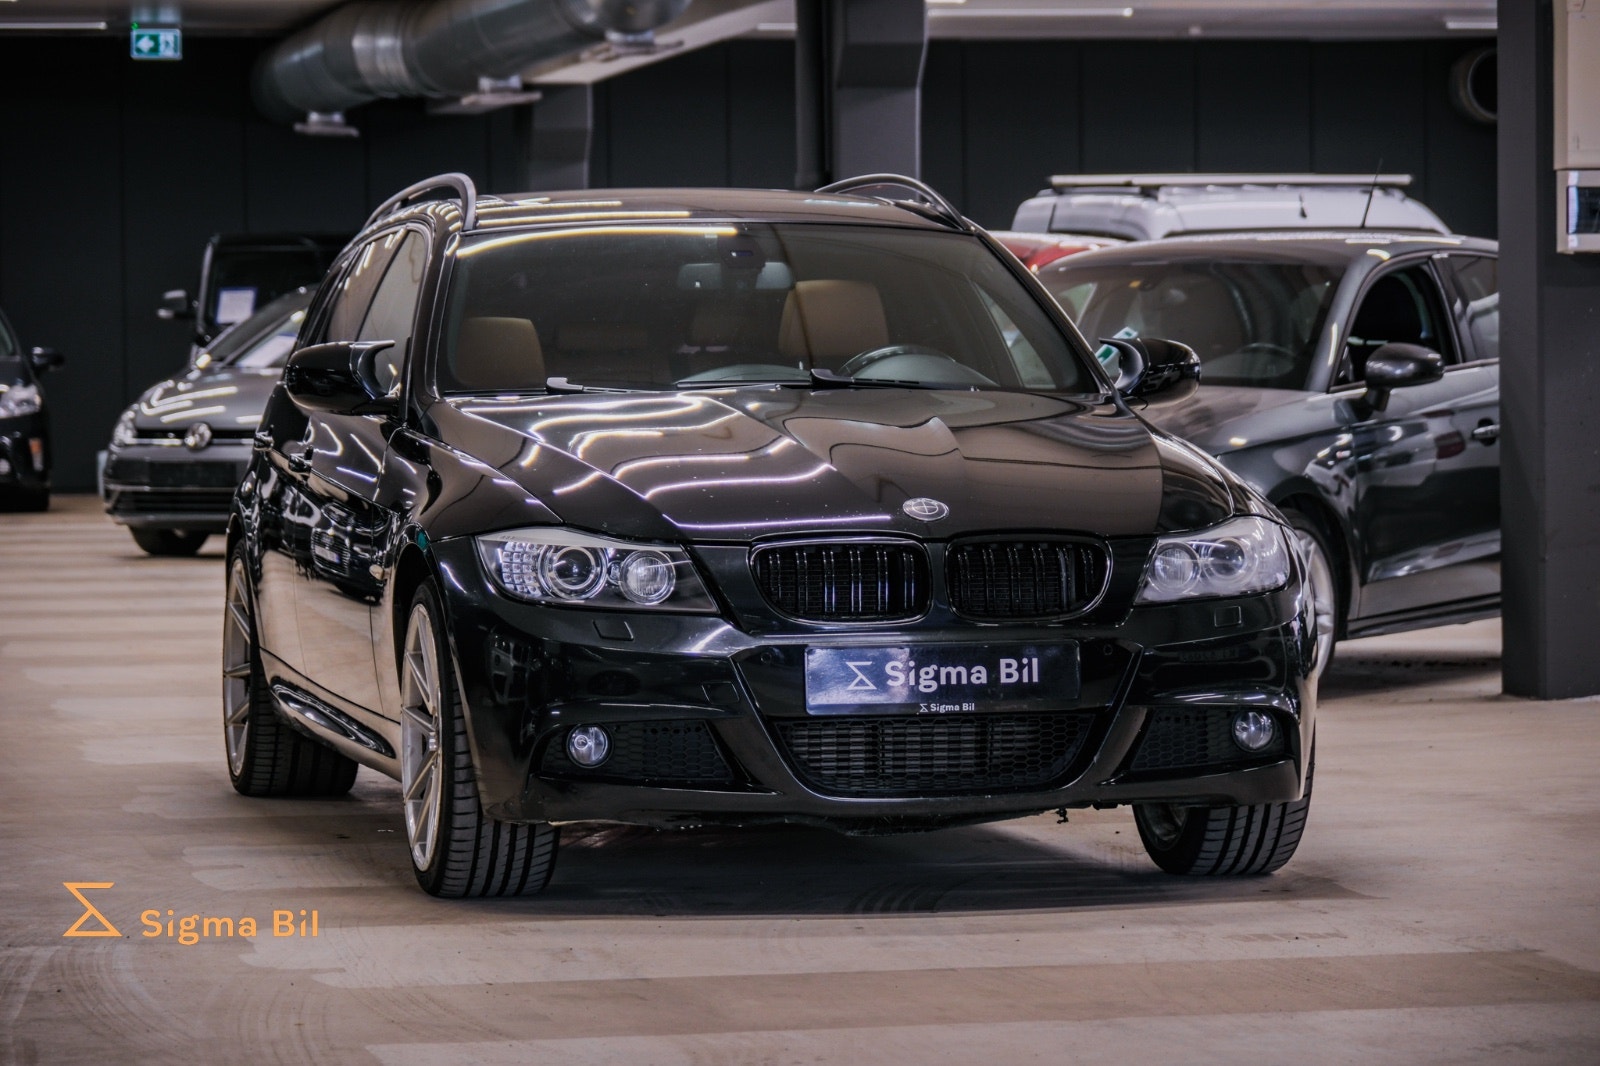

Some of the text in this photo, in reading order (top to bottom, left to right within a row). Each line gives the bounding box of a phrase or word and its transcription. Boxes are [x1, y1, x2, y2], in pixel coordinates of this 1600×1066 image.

[885, 657, 1039, 692] Sigma Bil
[930, 703, 975, 713] Sigma Bil
